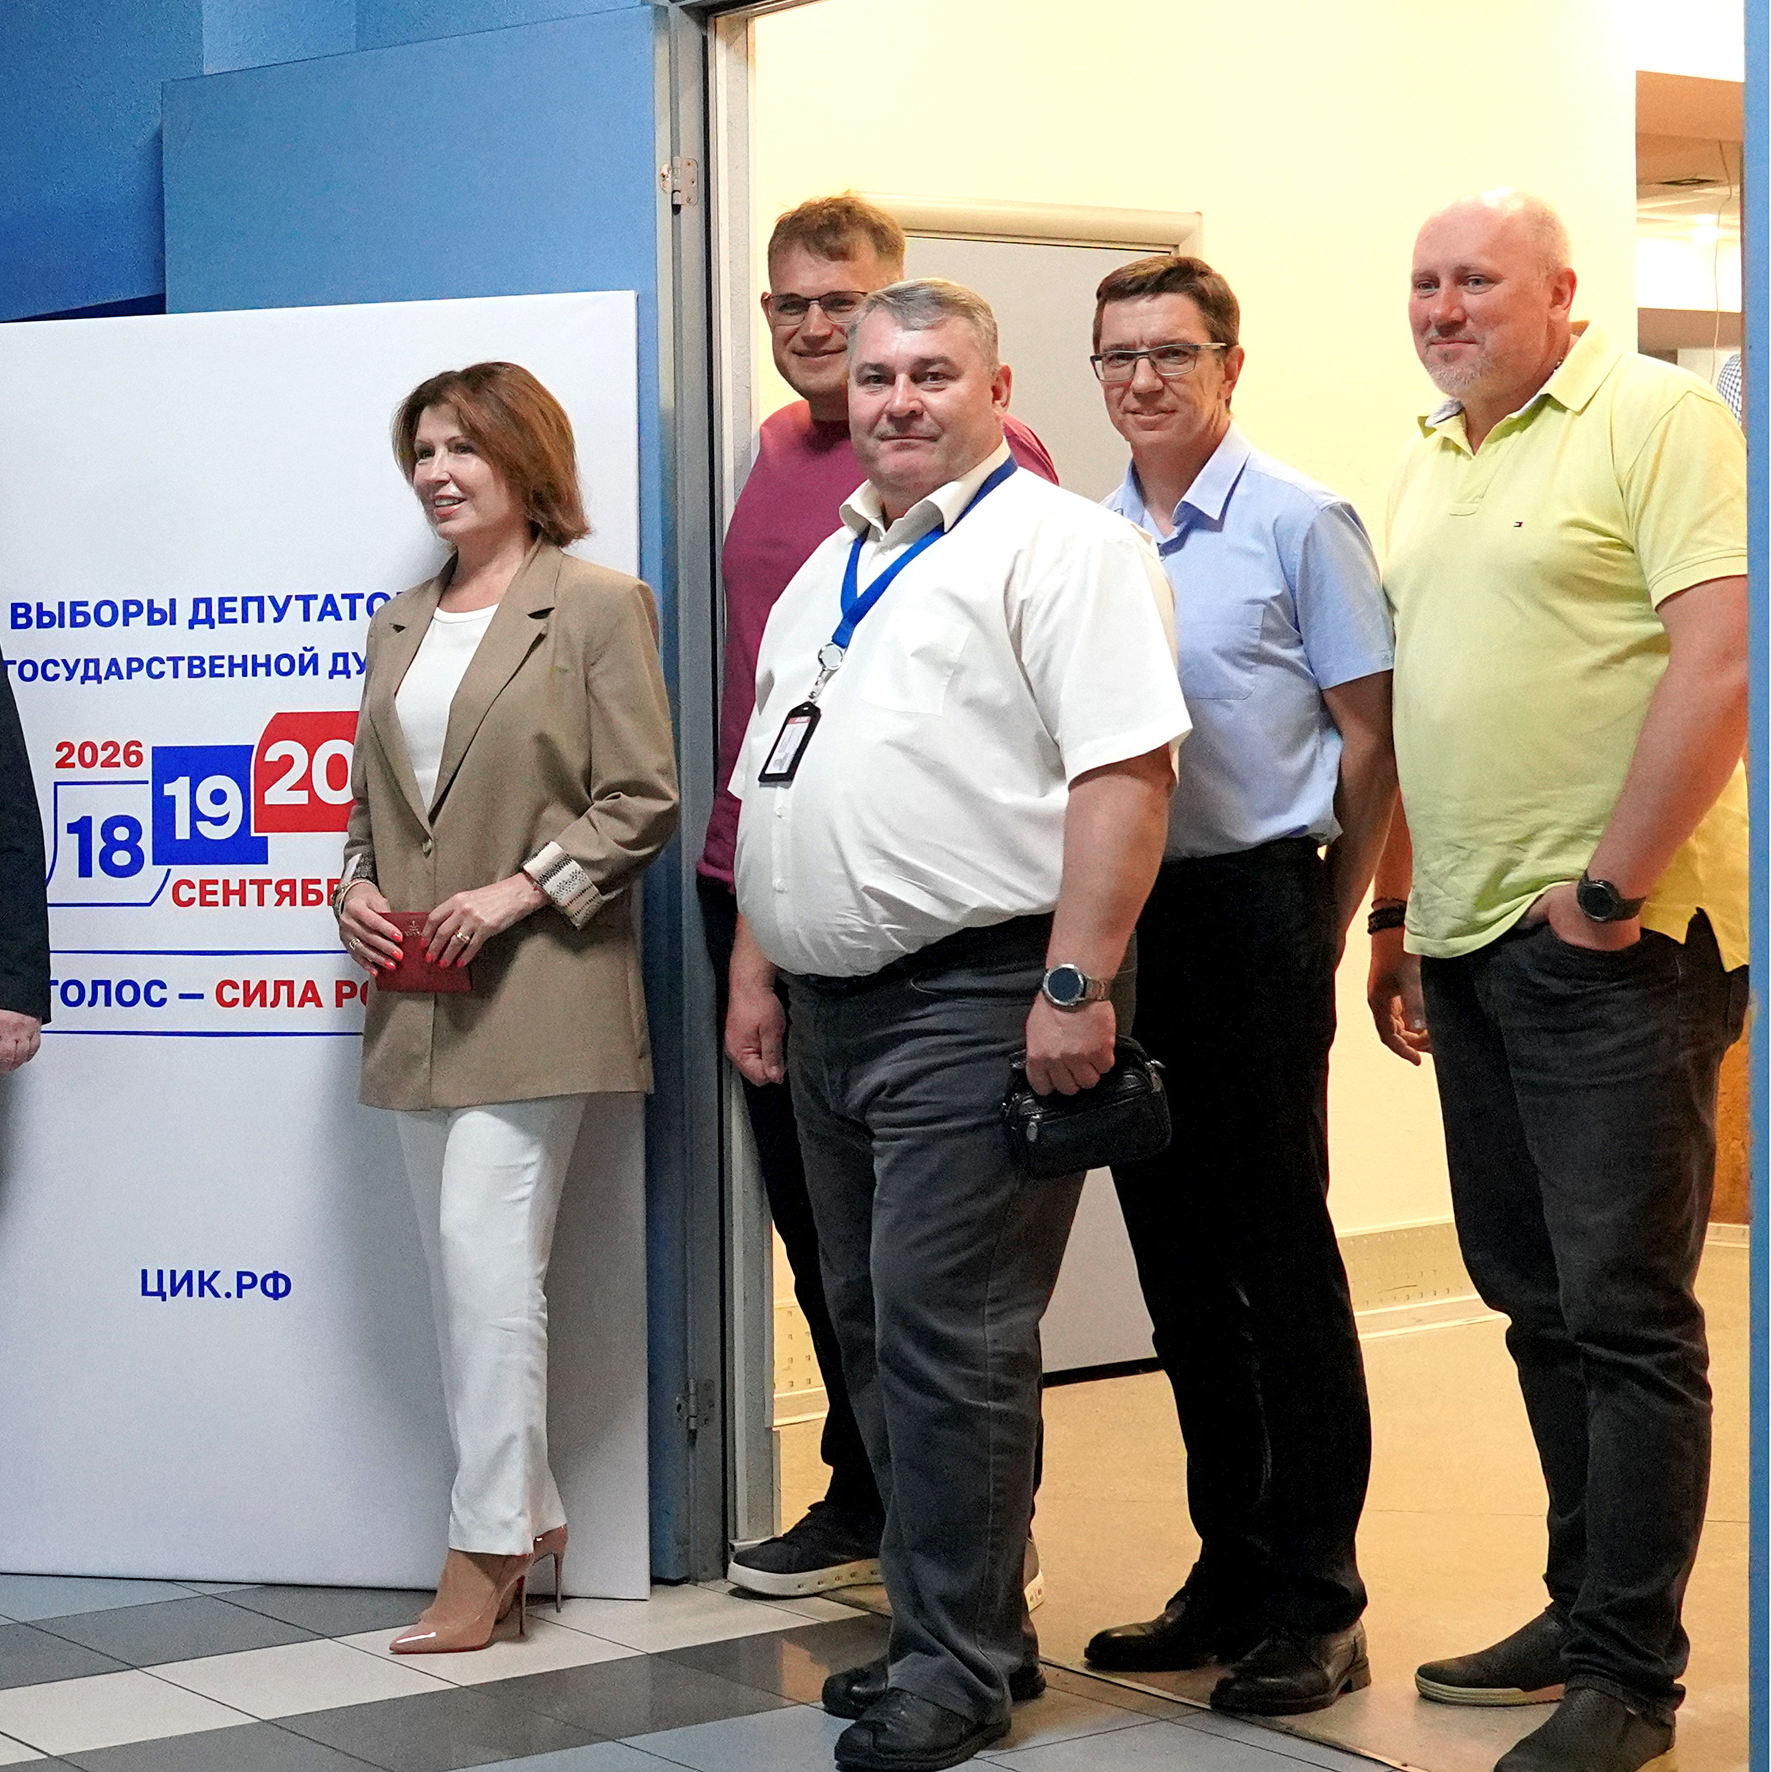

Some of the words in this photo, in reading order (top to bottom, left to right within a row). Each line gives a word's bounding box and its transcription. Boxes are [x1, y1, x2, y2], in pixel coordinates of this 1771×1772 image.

[10, 599, 177, 630] ВЫБОРЫ
[188, 591, 403, 630] ДЕПУТАТО
[55, 740, 144, 769] 2026
[66, 815, 145, 879] 18
[163, 774, 243, 840] 19
[264, 740, 353, 805] 20
[215, 979, 323, 1008] СИЛА
[140, 1268, 292, 1302] ЦИК.РФ
